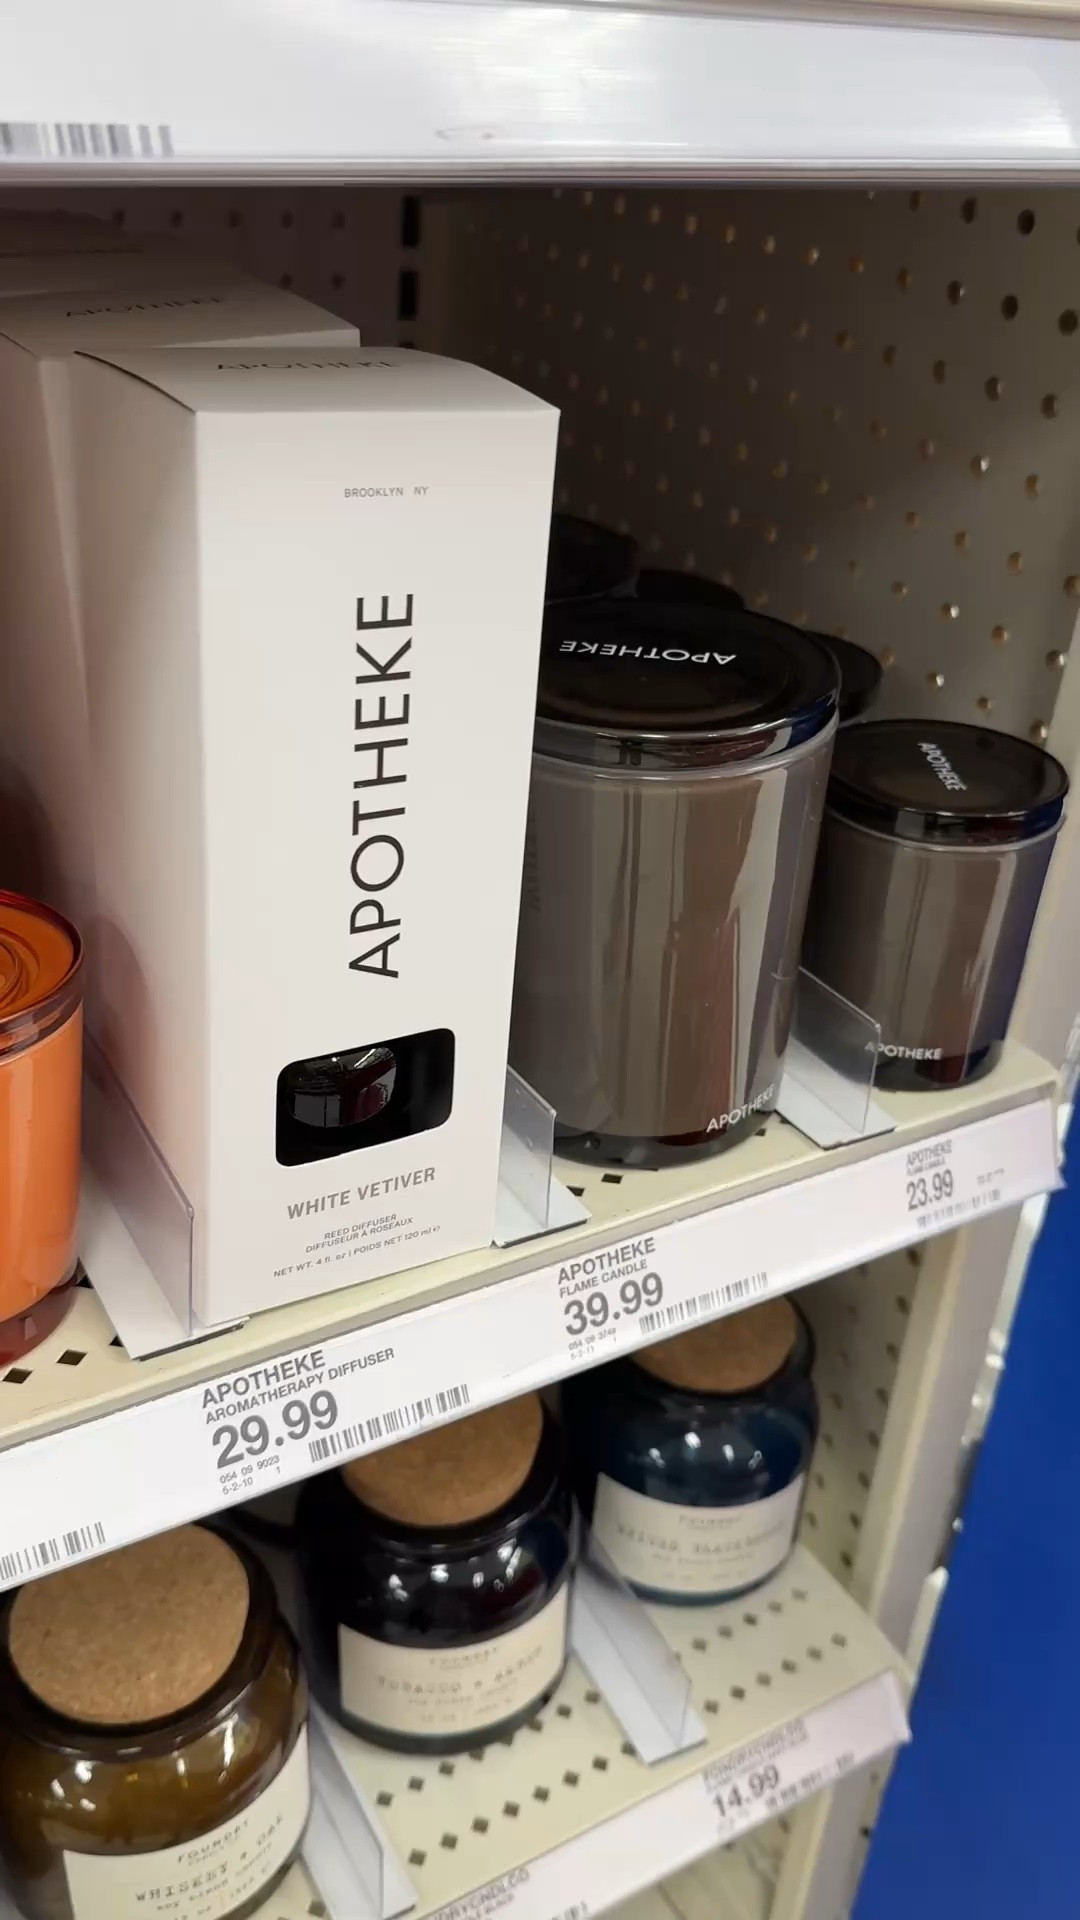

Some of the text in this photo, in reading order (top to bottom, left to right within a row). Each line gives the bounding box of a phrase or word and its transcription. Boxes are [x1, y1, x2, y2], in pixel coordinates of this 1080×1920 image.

[344, 485, 429, 498] BROOKLYN NY
[559, 640, 737, 665] APOTHEKE
[348, 593, 414, 979] APOTHEKE
[287, 1167, 435, 1220] WHITE VETIVER
[906, 1169, 953, 1212] 23.99
[305, 1232, 359, 1253] DIFFUSEUR
[370, 1217, 413, 1235] ROSEAUX
[324, 1214, 397, 1240] REED DIFFUSER
[273, 1266, 293, 1278] NET
[296, 1260, 314, 1273] WT.
[316, 1257, 322, 1265] 4
[353, 1241, 382, 1255] POIDS
[384, 1235, 402, 1247] NET
[404, 1230, 420, 1241] 120
[557, 1237, 656, 1285] APOTHEKE
[559, 1259, 648, 1299] FLAME CANDLE
[563, 1271, 663, 1336] 39.99
[202, 1350, 326, 1409] APOTHEKE
[205, 1348, 395, 1425] AROMATHERAPY DIFFUSER
[212, 1390, 338, 1469] 29.99
[220, 1455, 280, 1484] 054 09 9023
[712, 1764, 779, 1817] 14.99
